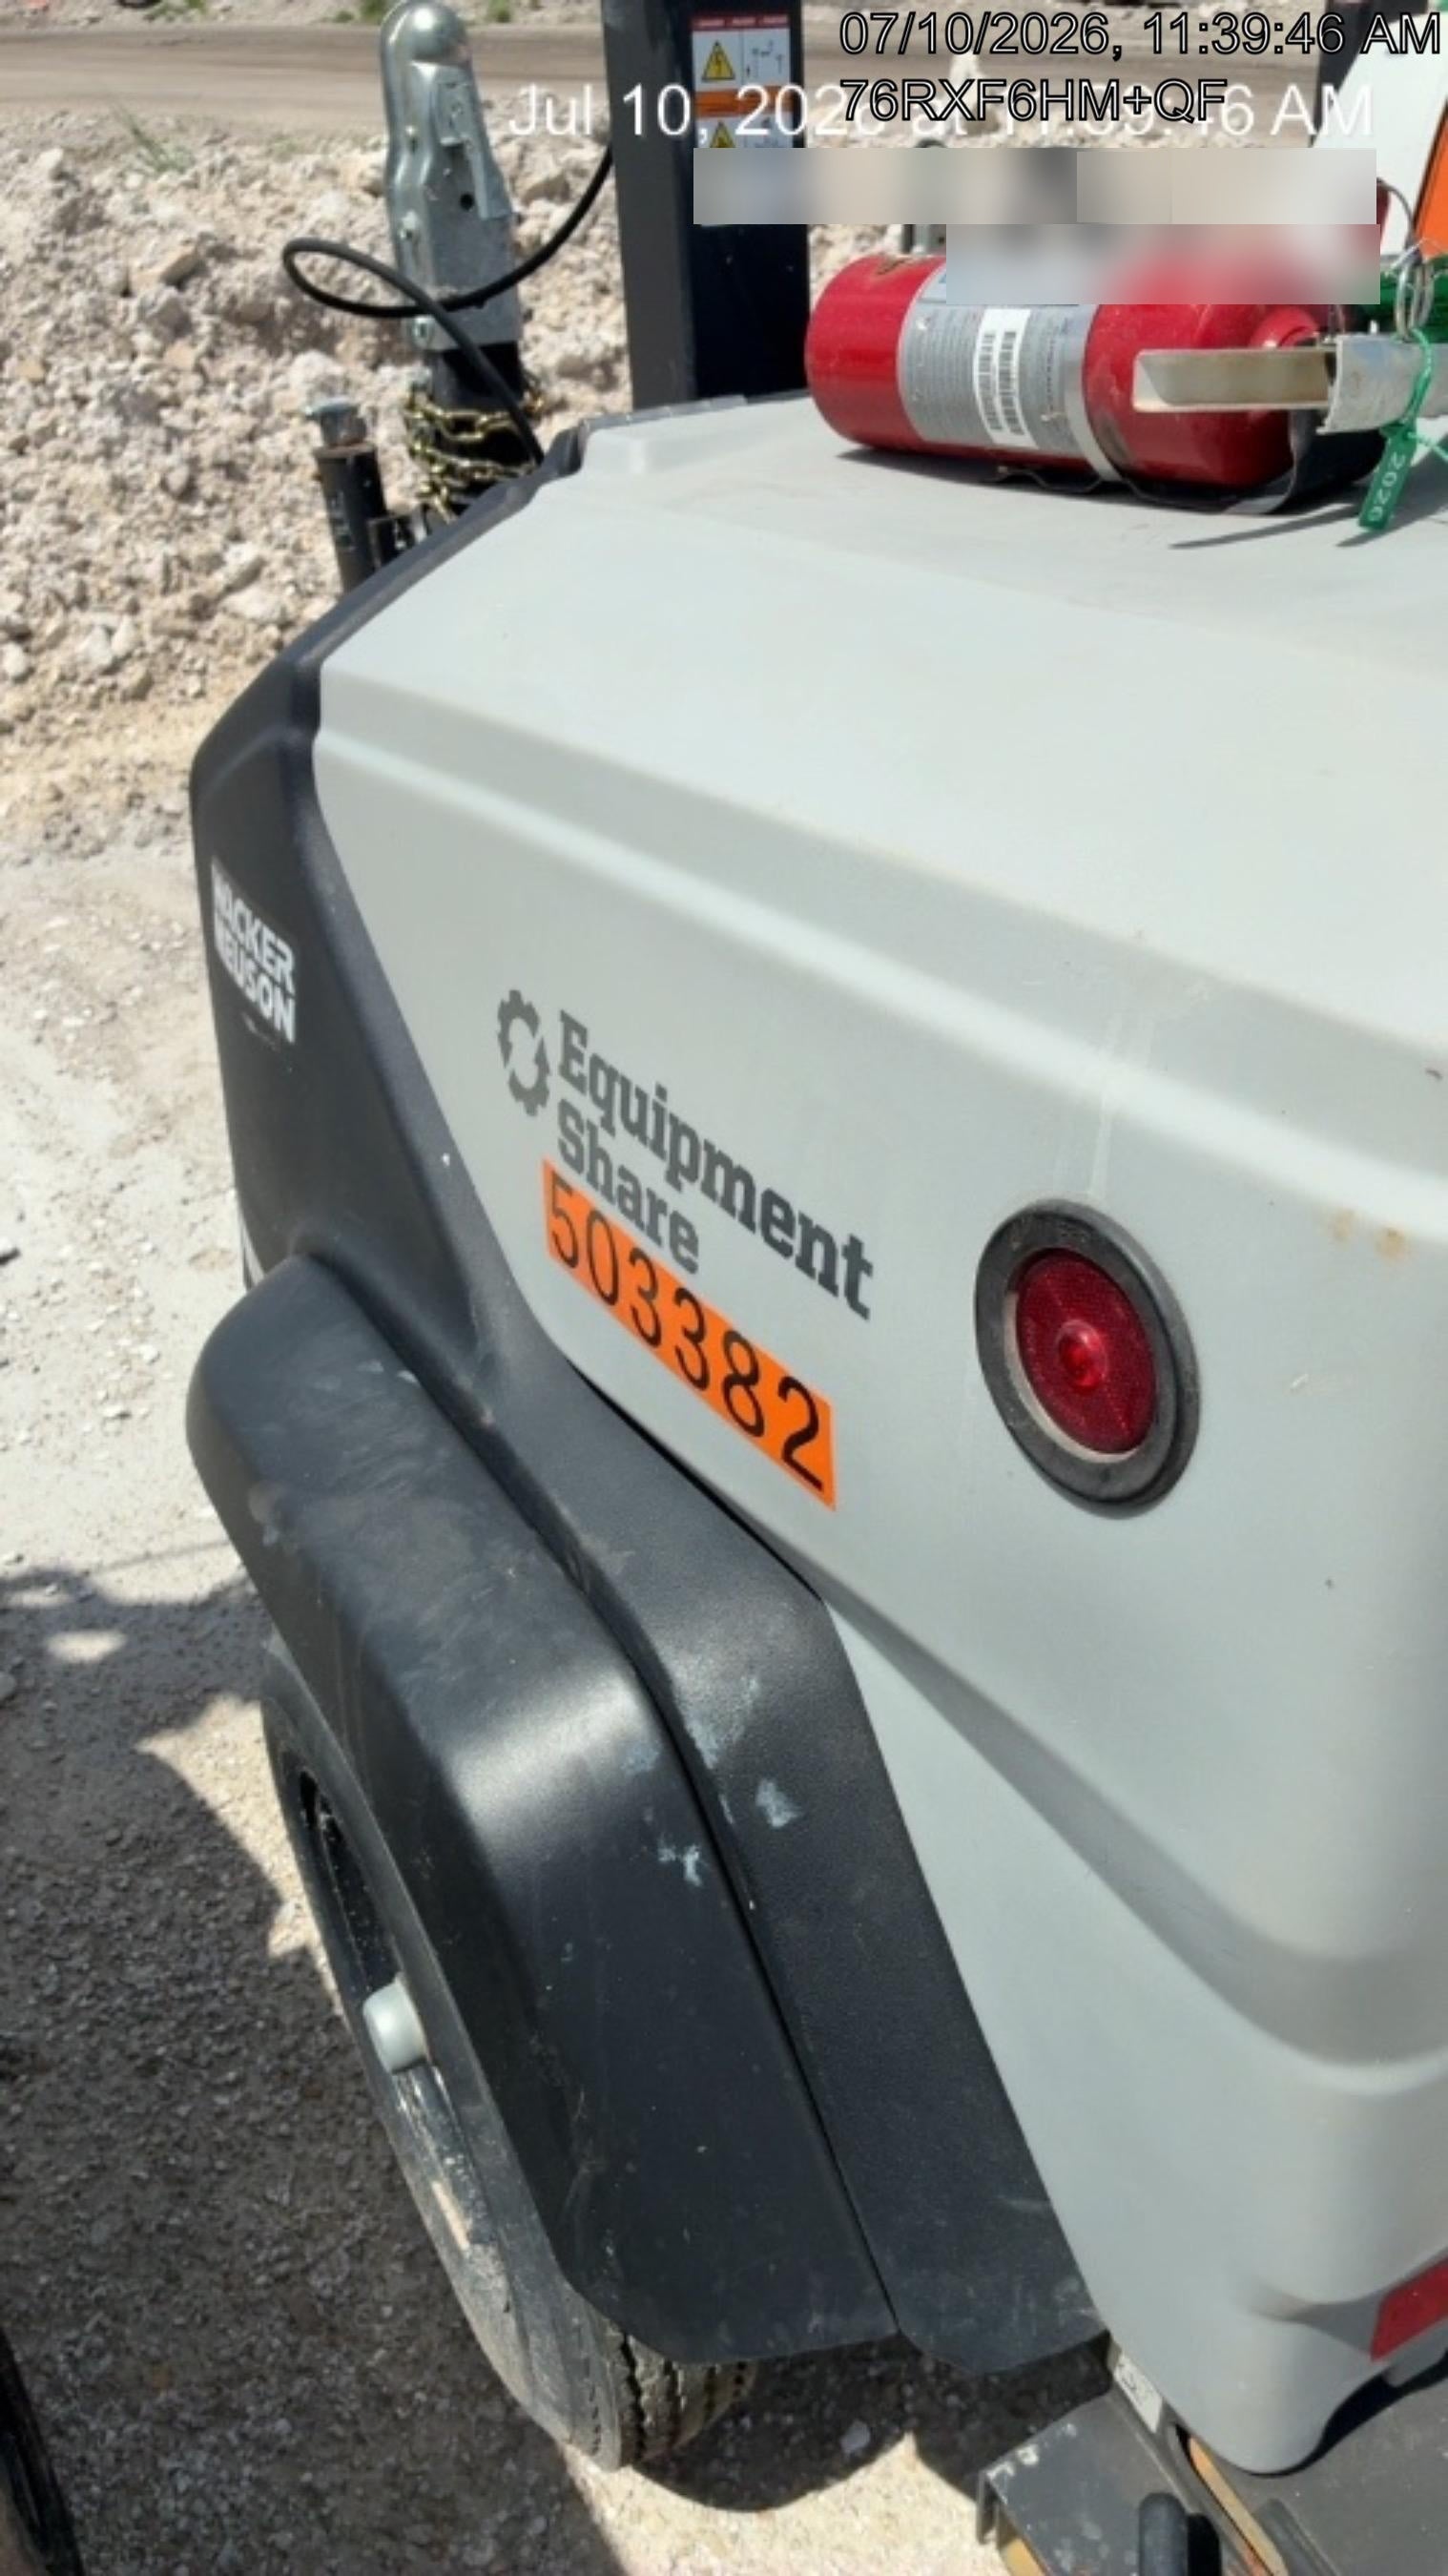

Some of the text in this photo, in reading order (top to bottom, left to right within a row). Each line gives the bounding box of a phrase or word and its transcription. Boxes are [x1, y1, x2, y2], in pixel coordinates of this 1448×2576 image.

[557, 1097, 700, 1274] Share
[558, 1008, 874, 1320] Equipment
[550, 1169, 824, 1492] 503382
